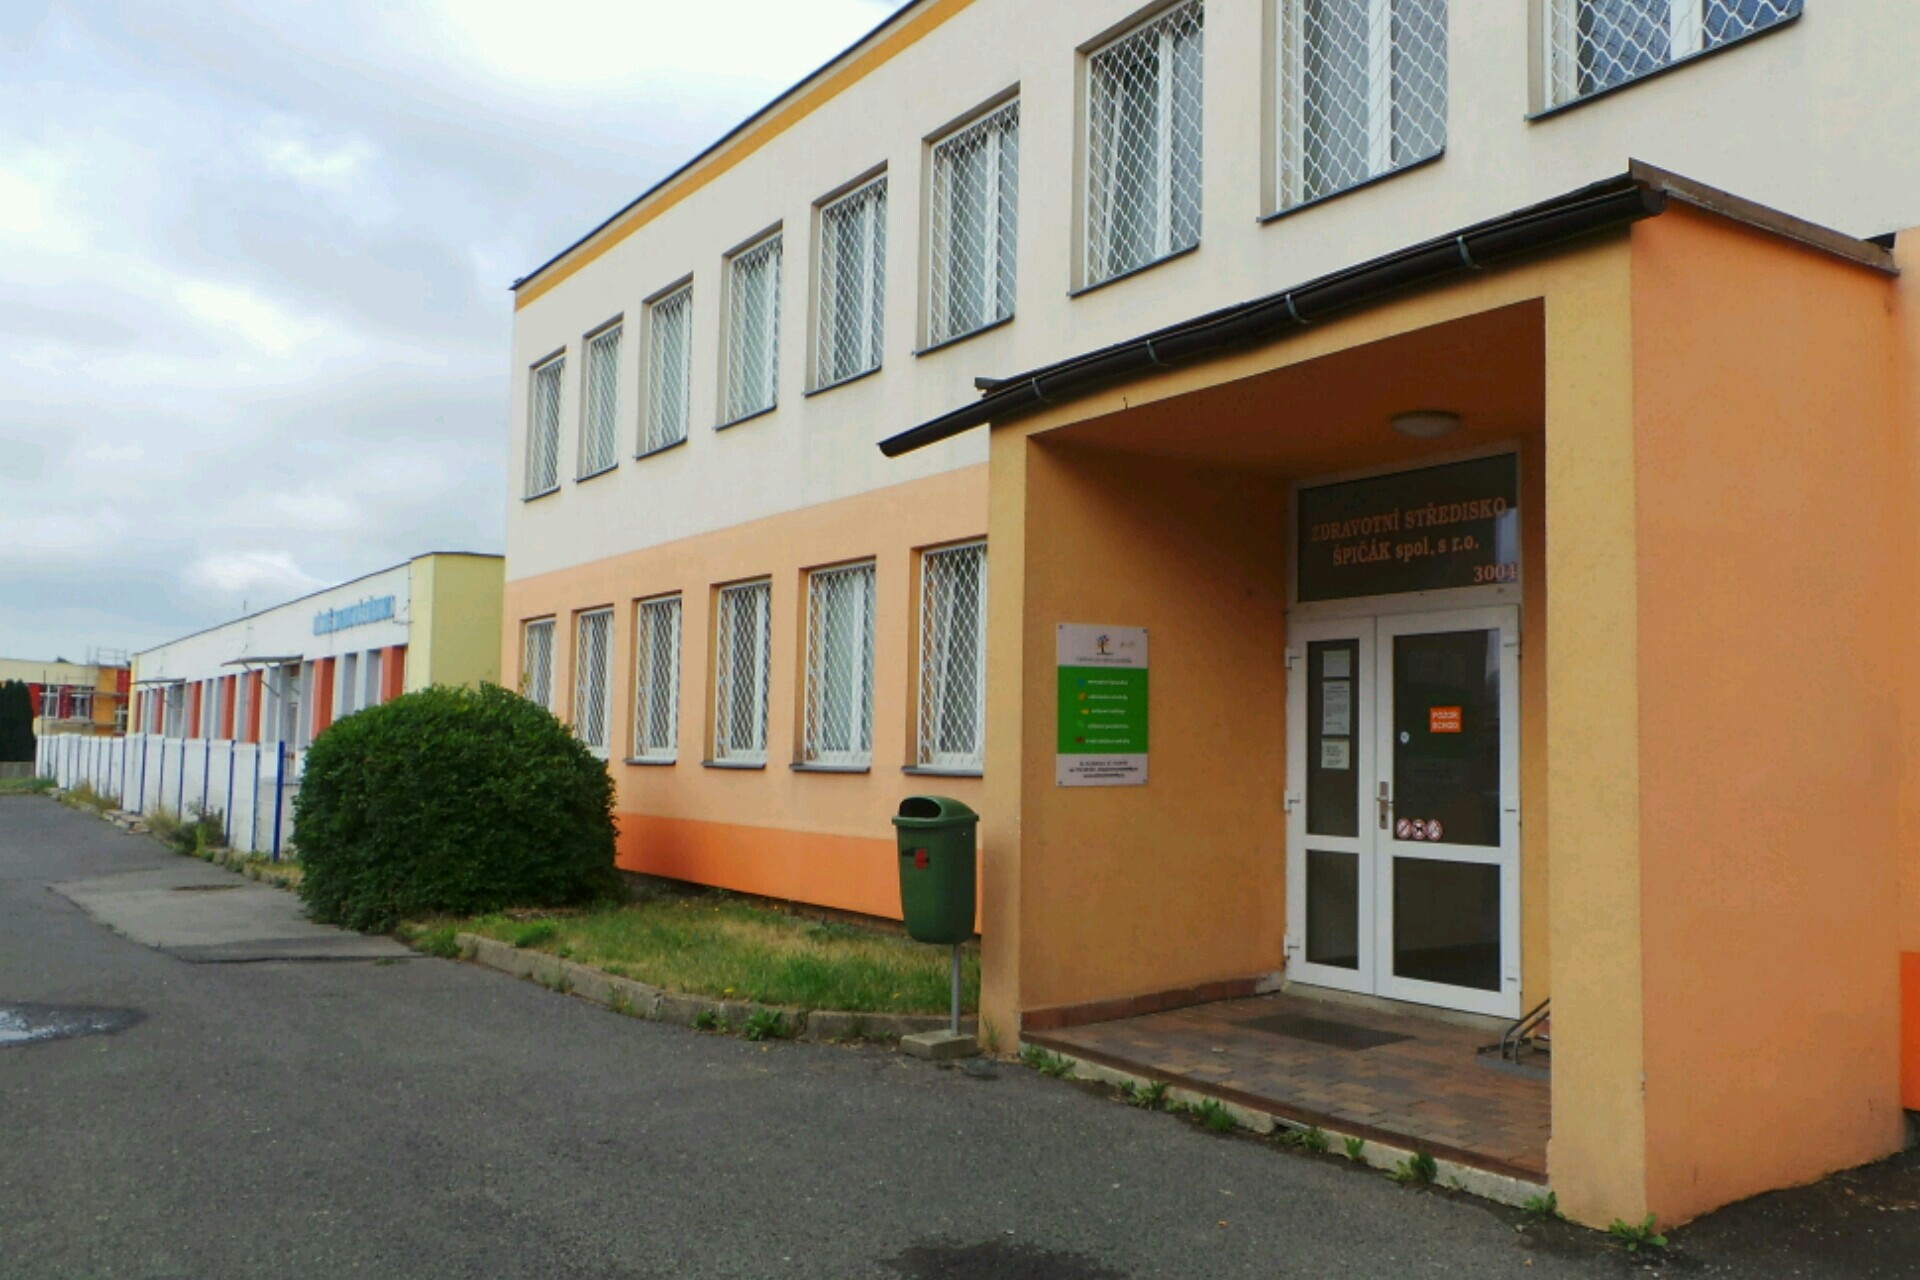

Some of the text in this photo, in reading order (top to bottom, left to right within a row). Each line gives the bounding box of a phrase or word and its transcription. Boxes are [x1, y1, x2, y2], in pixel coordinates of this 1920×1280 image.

[1311, 497, 1507, 542] ZDRAVOTNÍ STŘEDISKO
[1333, 535, 1479, 566] ŠPIČÁK spol. s r.o.
[1473, 561, 1518, 582] 3004
